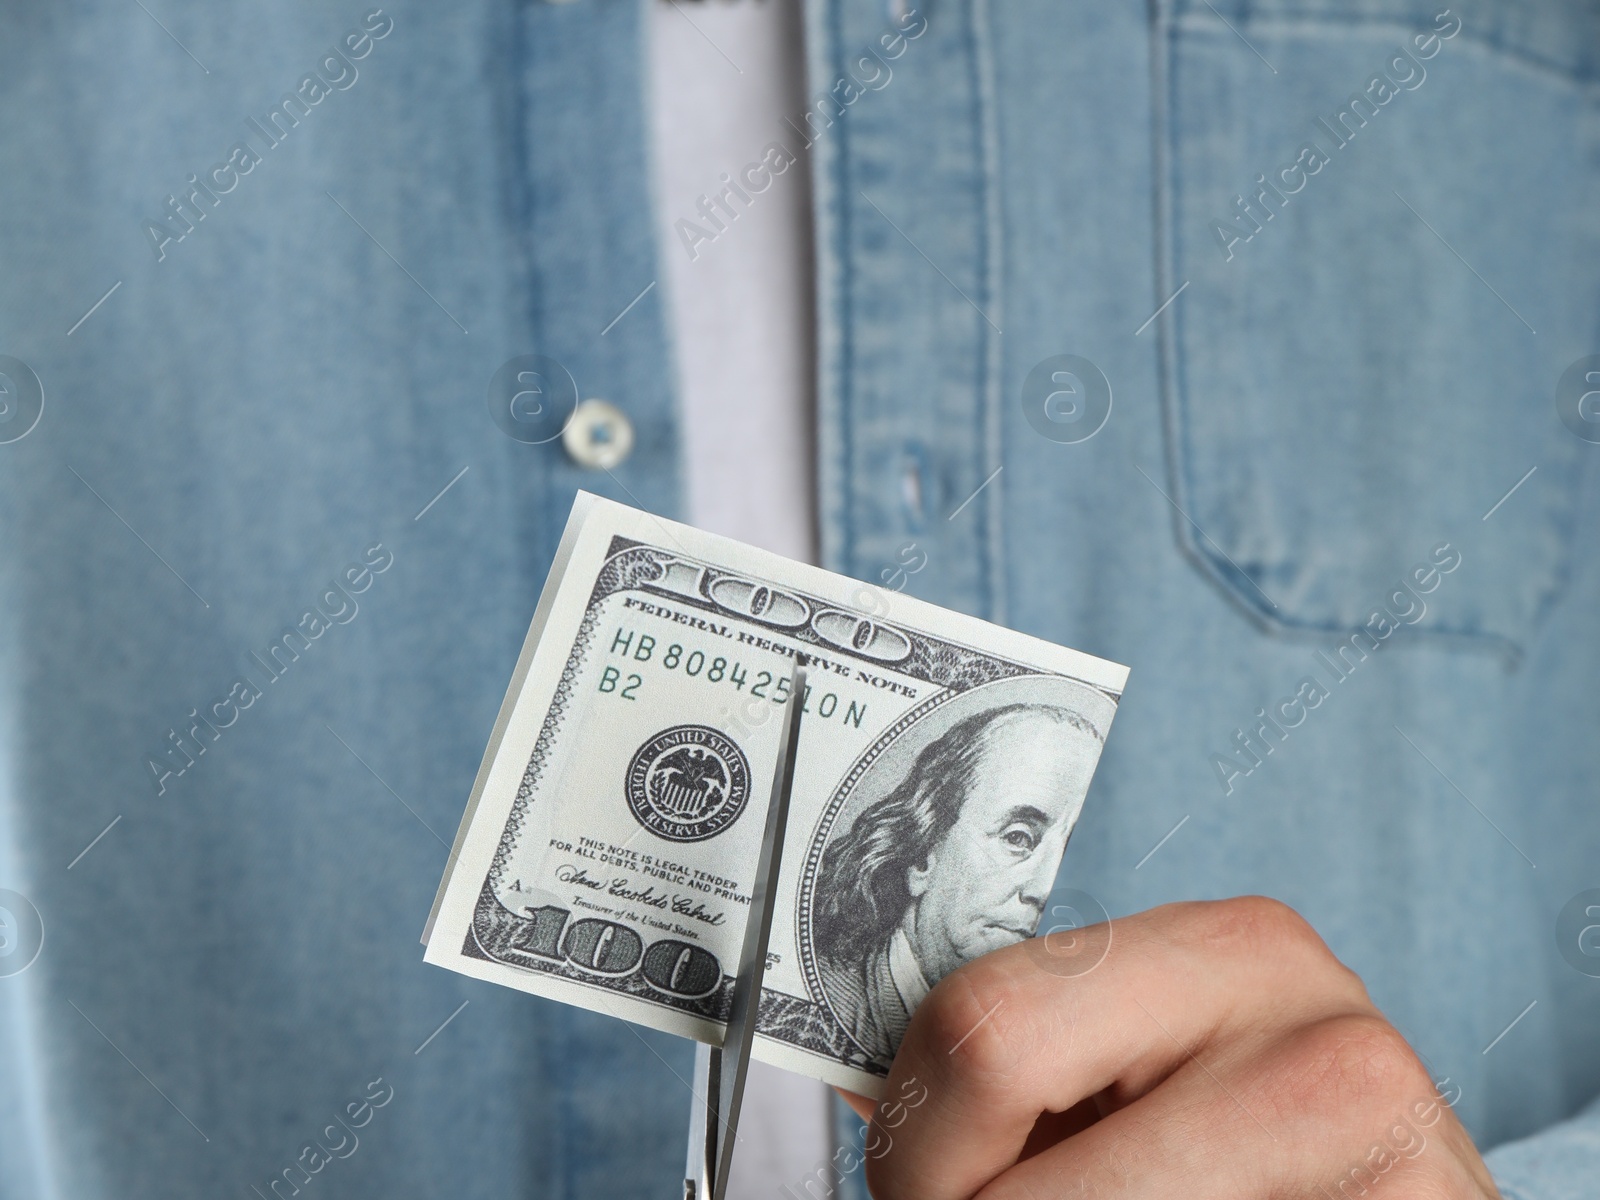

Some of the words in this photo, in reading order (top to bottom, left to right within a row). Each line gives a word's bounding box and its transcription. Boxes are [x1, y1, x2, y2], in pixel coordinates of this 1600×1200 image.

[640, 555, 912, 662] 100
[623, 597, 733, 639] FEDERAL
[855, 670, 917, 699] NOTE
[599, 666, 643, 701] B2
[653, 731, 706, 752] UNITED
[709, 736, 740, 773] STATES
[646, 812, 702, 836] RESERVE
[706, 785, 744, 829] SYSTEM
[549, 838, 573, 853] FOR
[575, 846, 596, 860] ALL
[599, 853, 639, 873] DEBTS,
[643, 865, 685, 885] PUBLIC
[687, 879, 712, 893] AND
[714, 887, 752, 906] PRIVAT
[579, 836, 605, 851] THIS
[607, 844, 639, 861] NOTE
[641, 854, 653, 865] IS
[655, 858, 691, 877] LEGAL
[694, 869, 738, 891] TENDER
[614, 909, 626, 920] of
[625, 910, 639, 922] the
[641, 915, 673, 931] United
[511, 904, 725, 1000] 100
